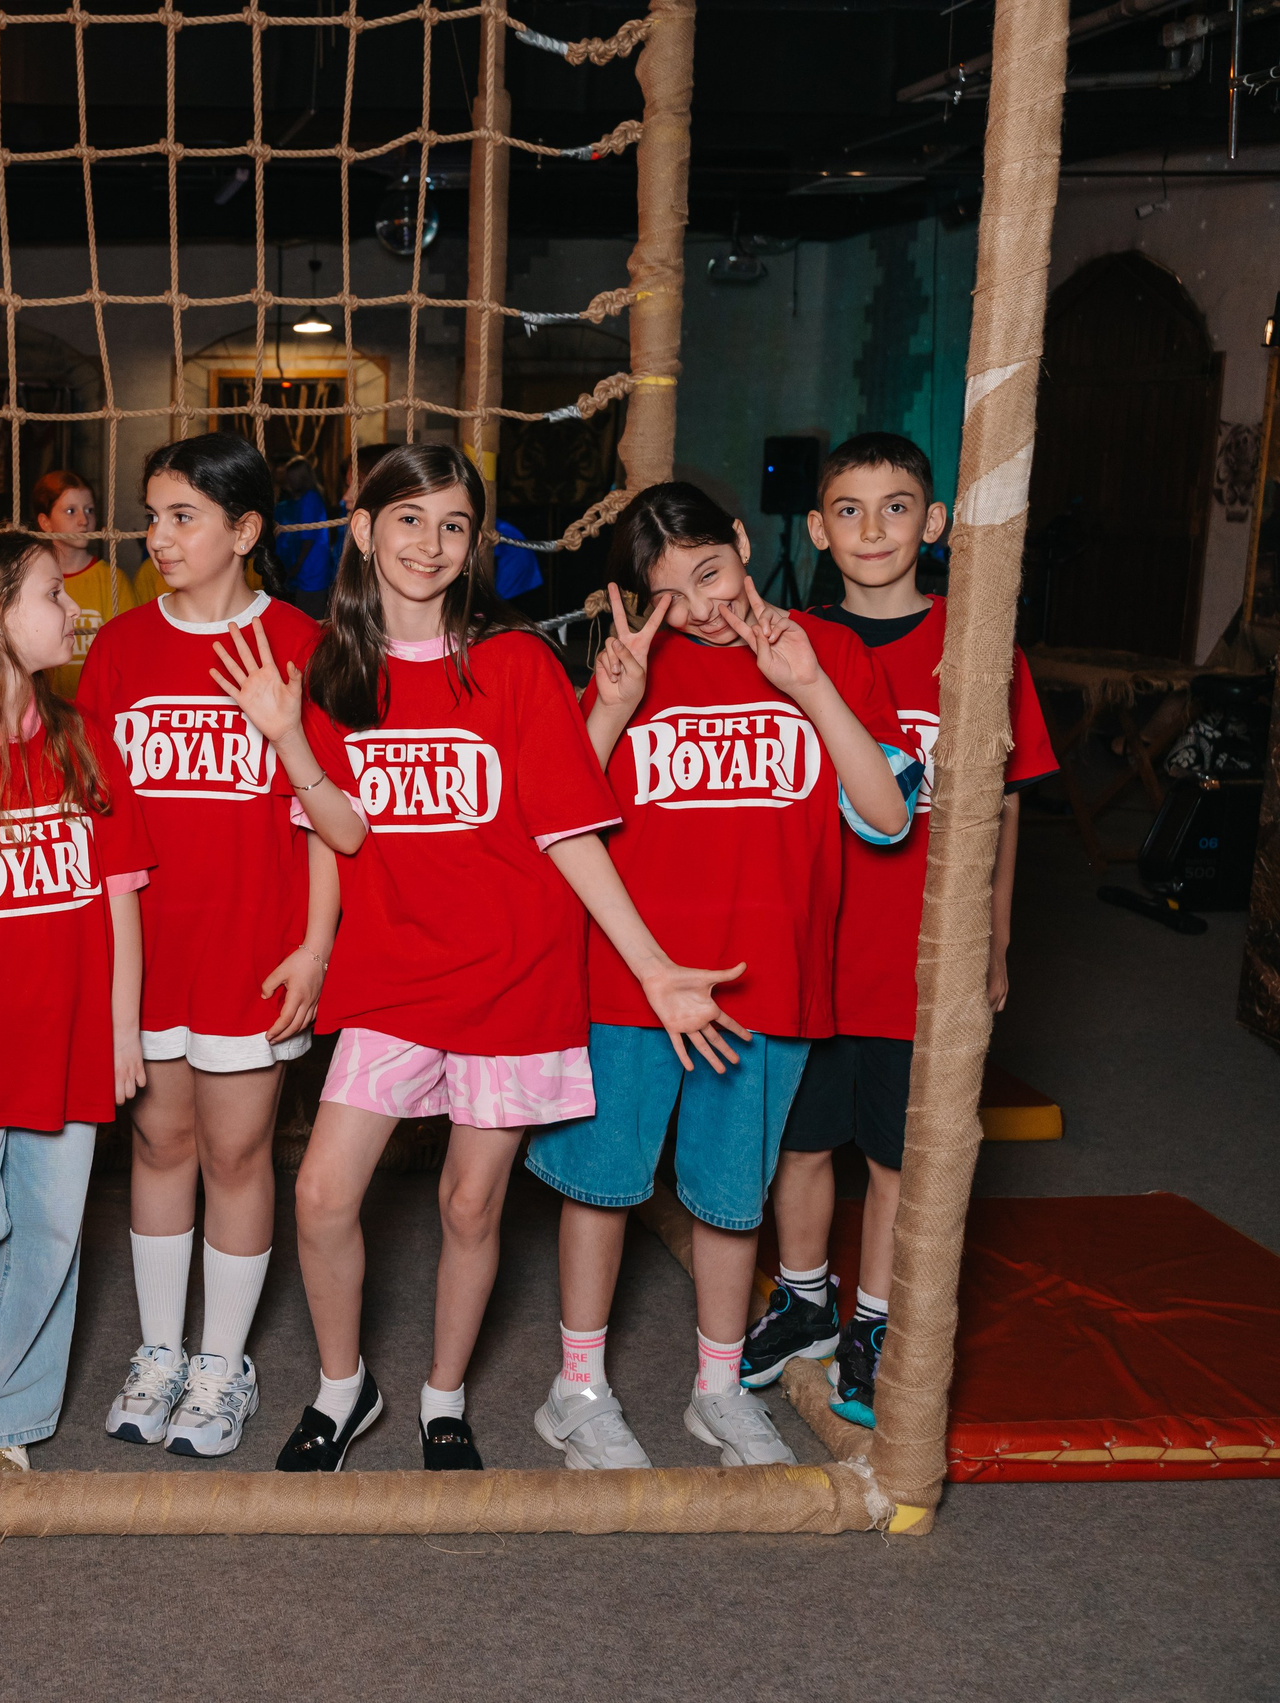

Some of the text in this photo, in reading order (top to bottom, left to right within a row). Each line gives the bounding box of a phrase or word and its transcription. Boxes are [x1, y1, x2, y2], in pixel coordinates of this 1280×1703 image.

[151, 710, 239, 729] FORT
[677, 715, 771, 738] FORT
[366, 743, 450, 763] FORT
[627, 715, 821, 805] BOYARD
[1198, 836, 1219, 849] 06
